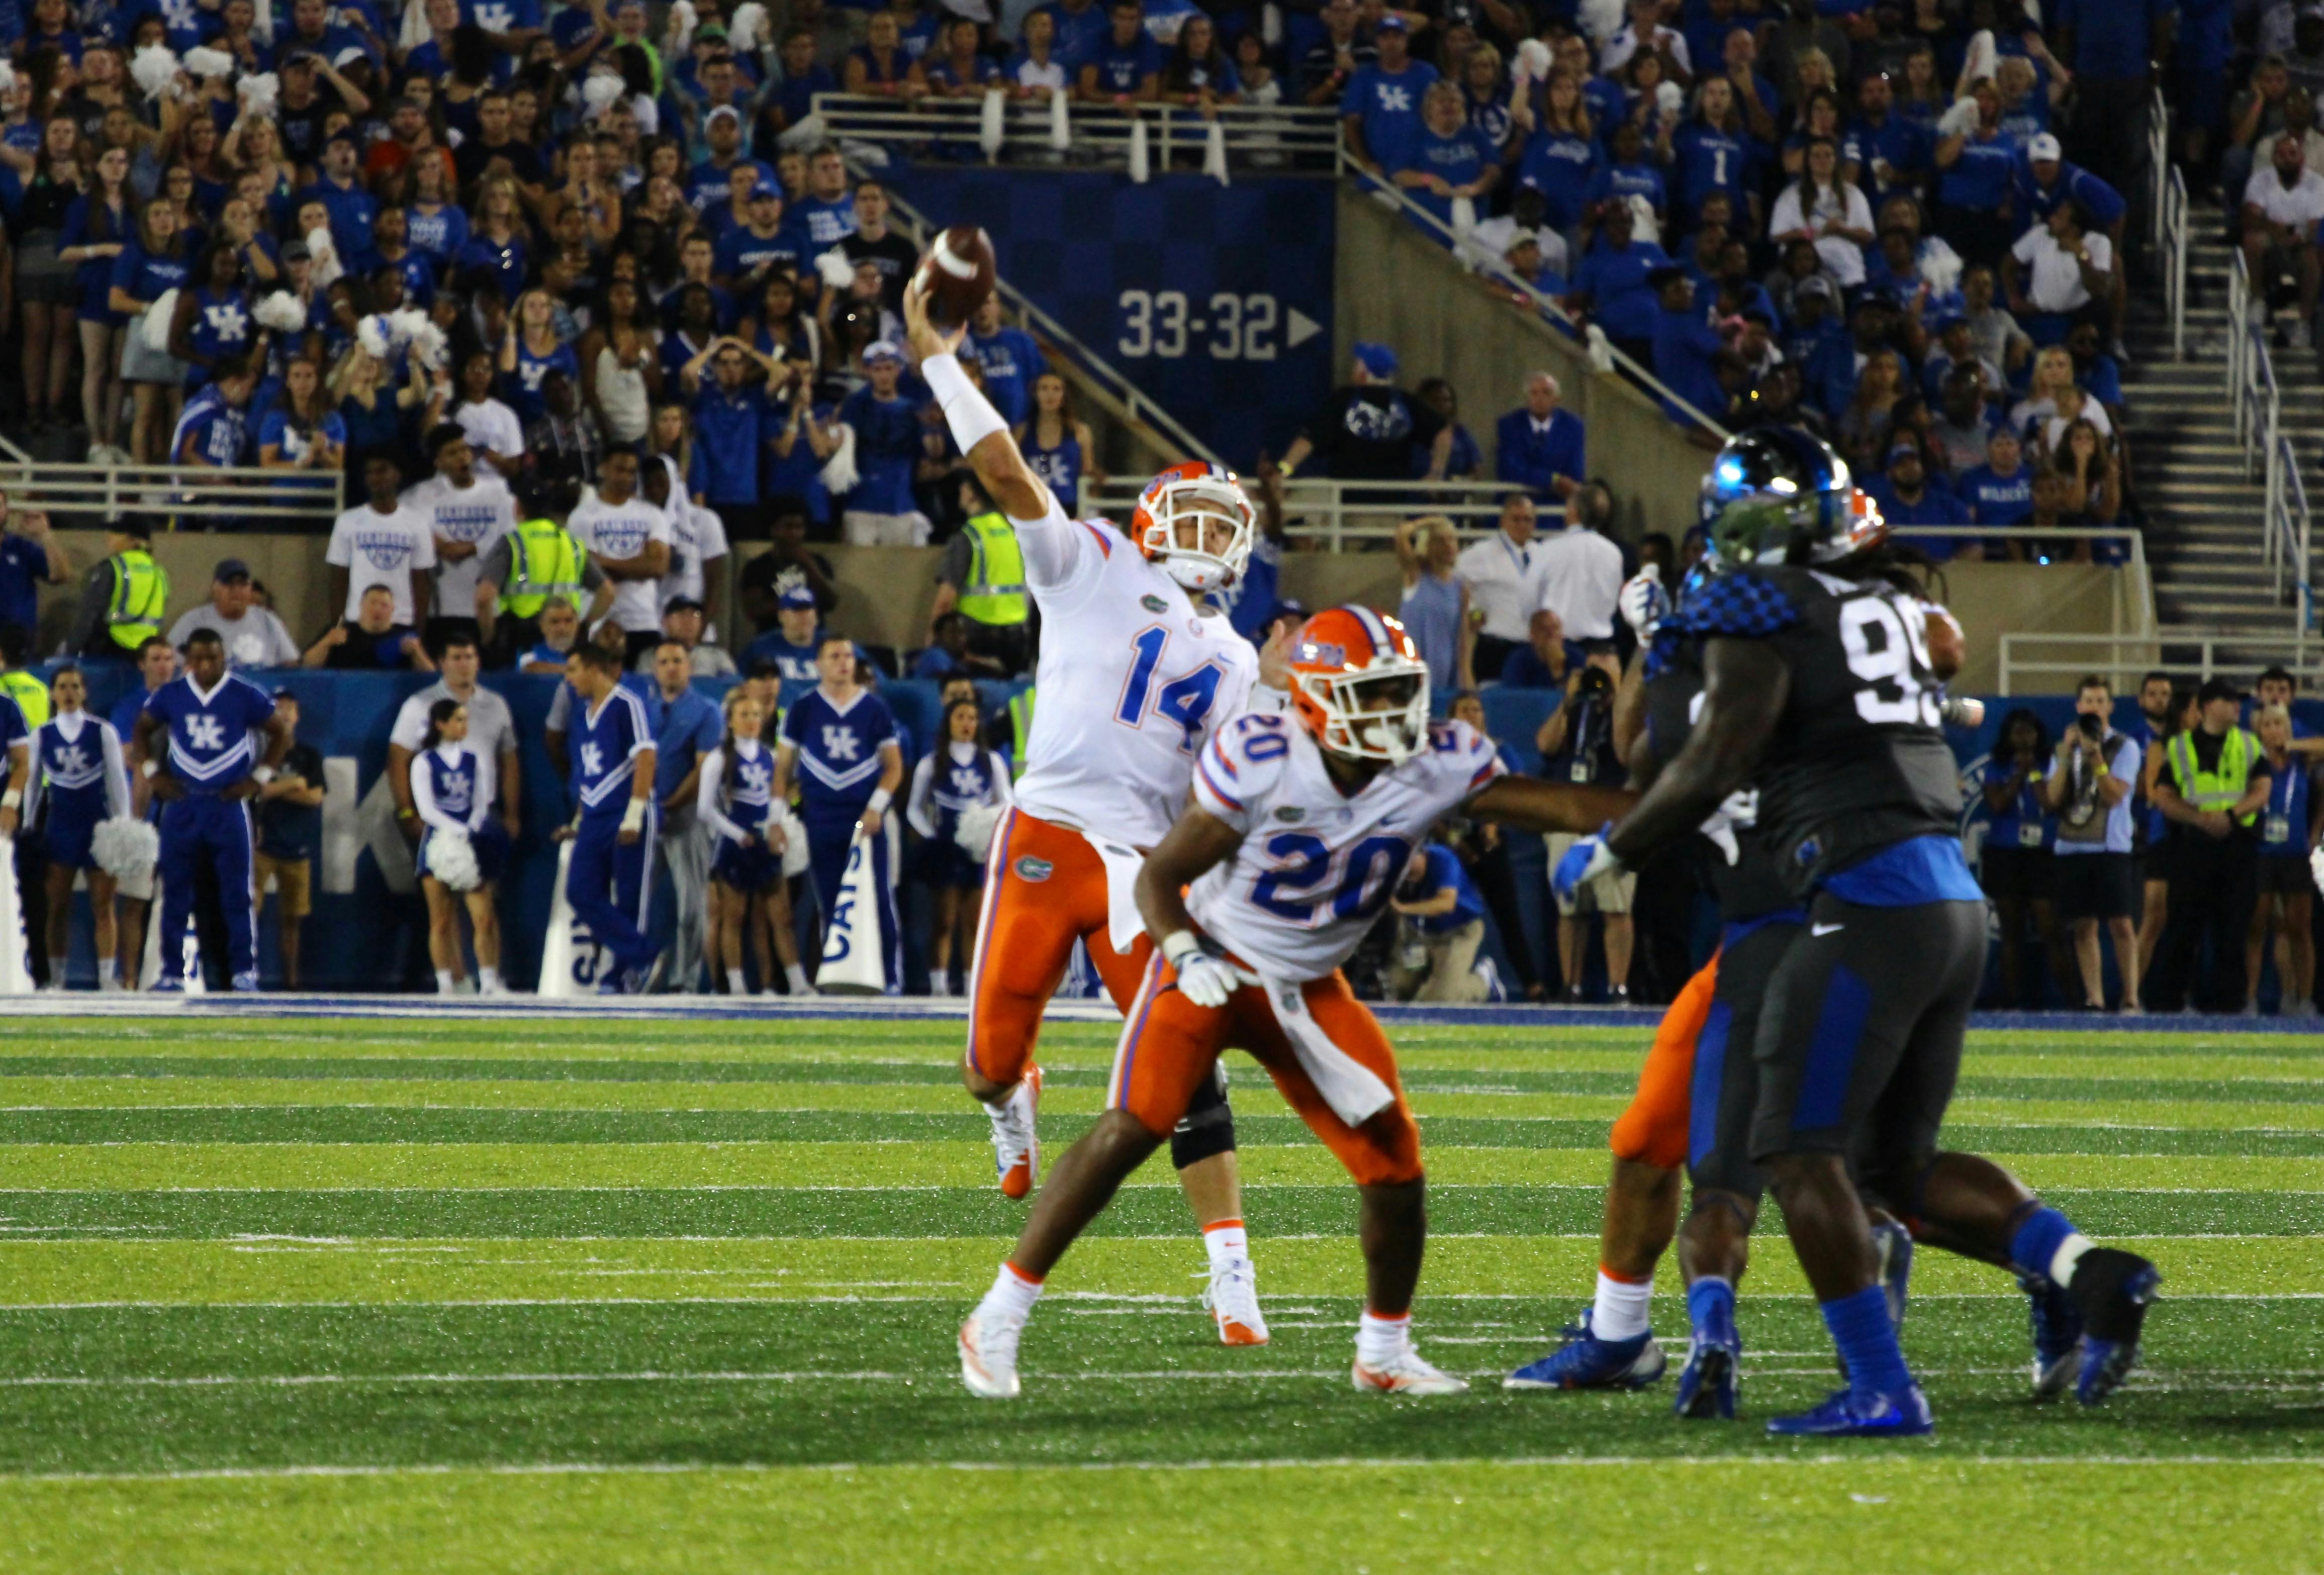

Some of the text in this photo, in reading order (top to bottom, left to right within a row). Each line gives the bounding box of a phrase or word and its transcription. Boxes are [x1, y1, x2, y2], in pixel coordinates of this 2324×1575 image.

[1376, 82, 1412, 111] UK
[204, 304, 248, 341] UK
[1118, 290, 1277, 360] 33-32
[1113, 622, 1228, 757] 14
[185, 714, 226, 750] UK
[821, 725, 861, 760] UK
[1234, 713, 1291, 767] 20
[54, 745, 90, 774] UK
[739, 763, 772, 791] UK
[949, 769, 984, 795] UK
[1243, 829, 1415, 930] 20
